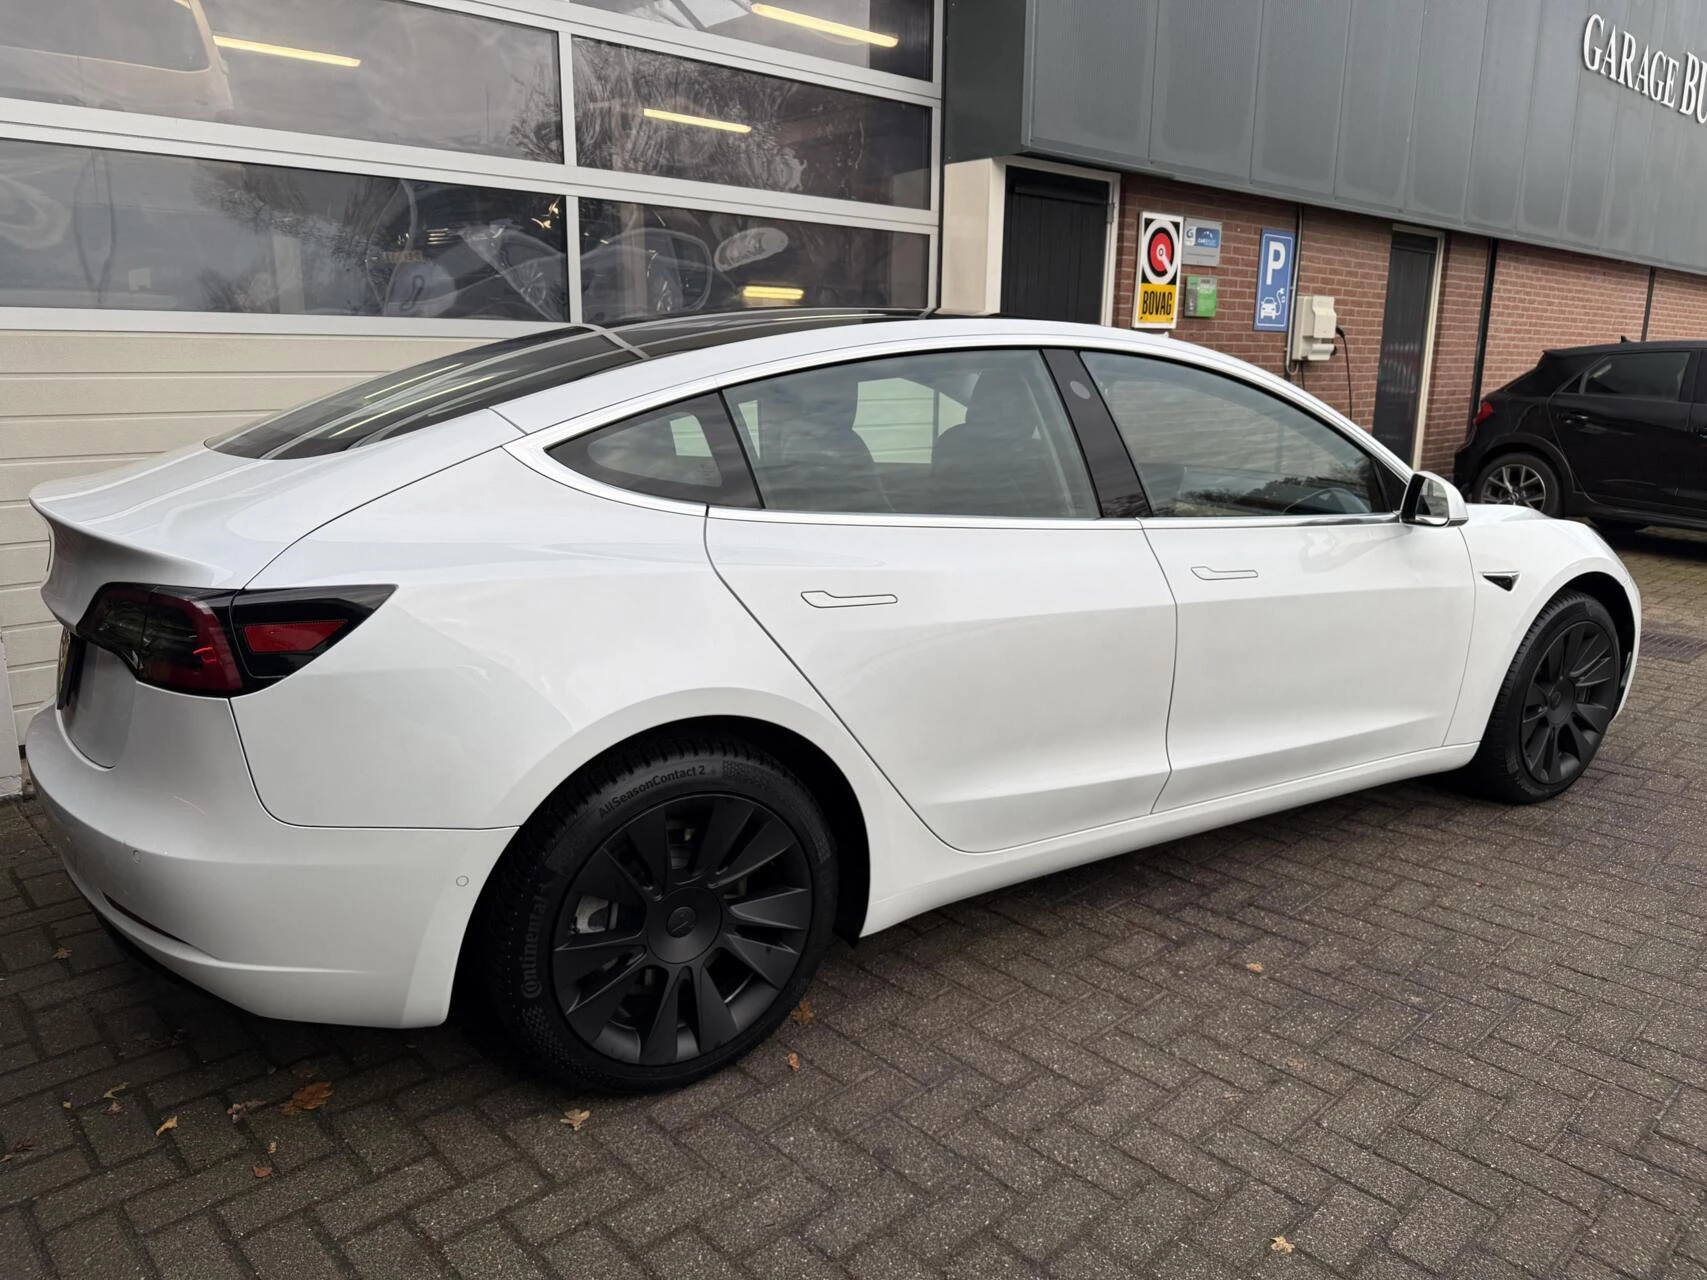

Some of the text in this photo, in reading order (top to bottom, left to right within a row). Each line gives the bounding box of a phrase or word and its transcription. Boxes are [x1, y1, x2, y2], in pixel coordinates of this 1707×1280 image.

[1583, 13, 1680, 109] GARAGE
[1265, 241, 1286, 286] P
[1142, 291, 1173, 316] BOVAG
[598, 764, 706, 819] AllSeasonContact 2
[519, 895, 549, 999] Continental
